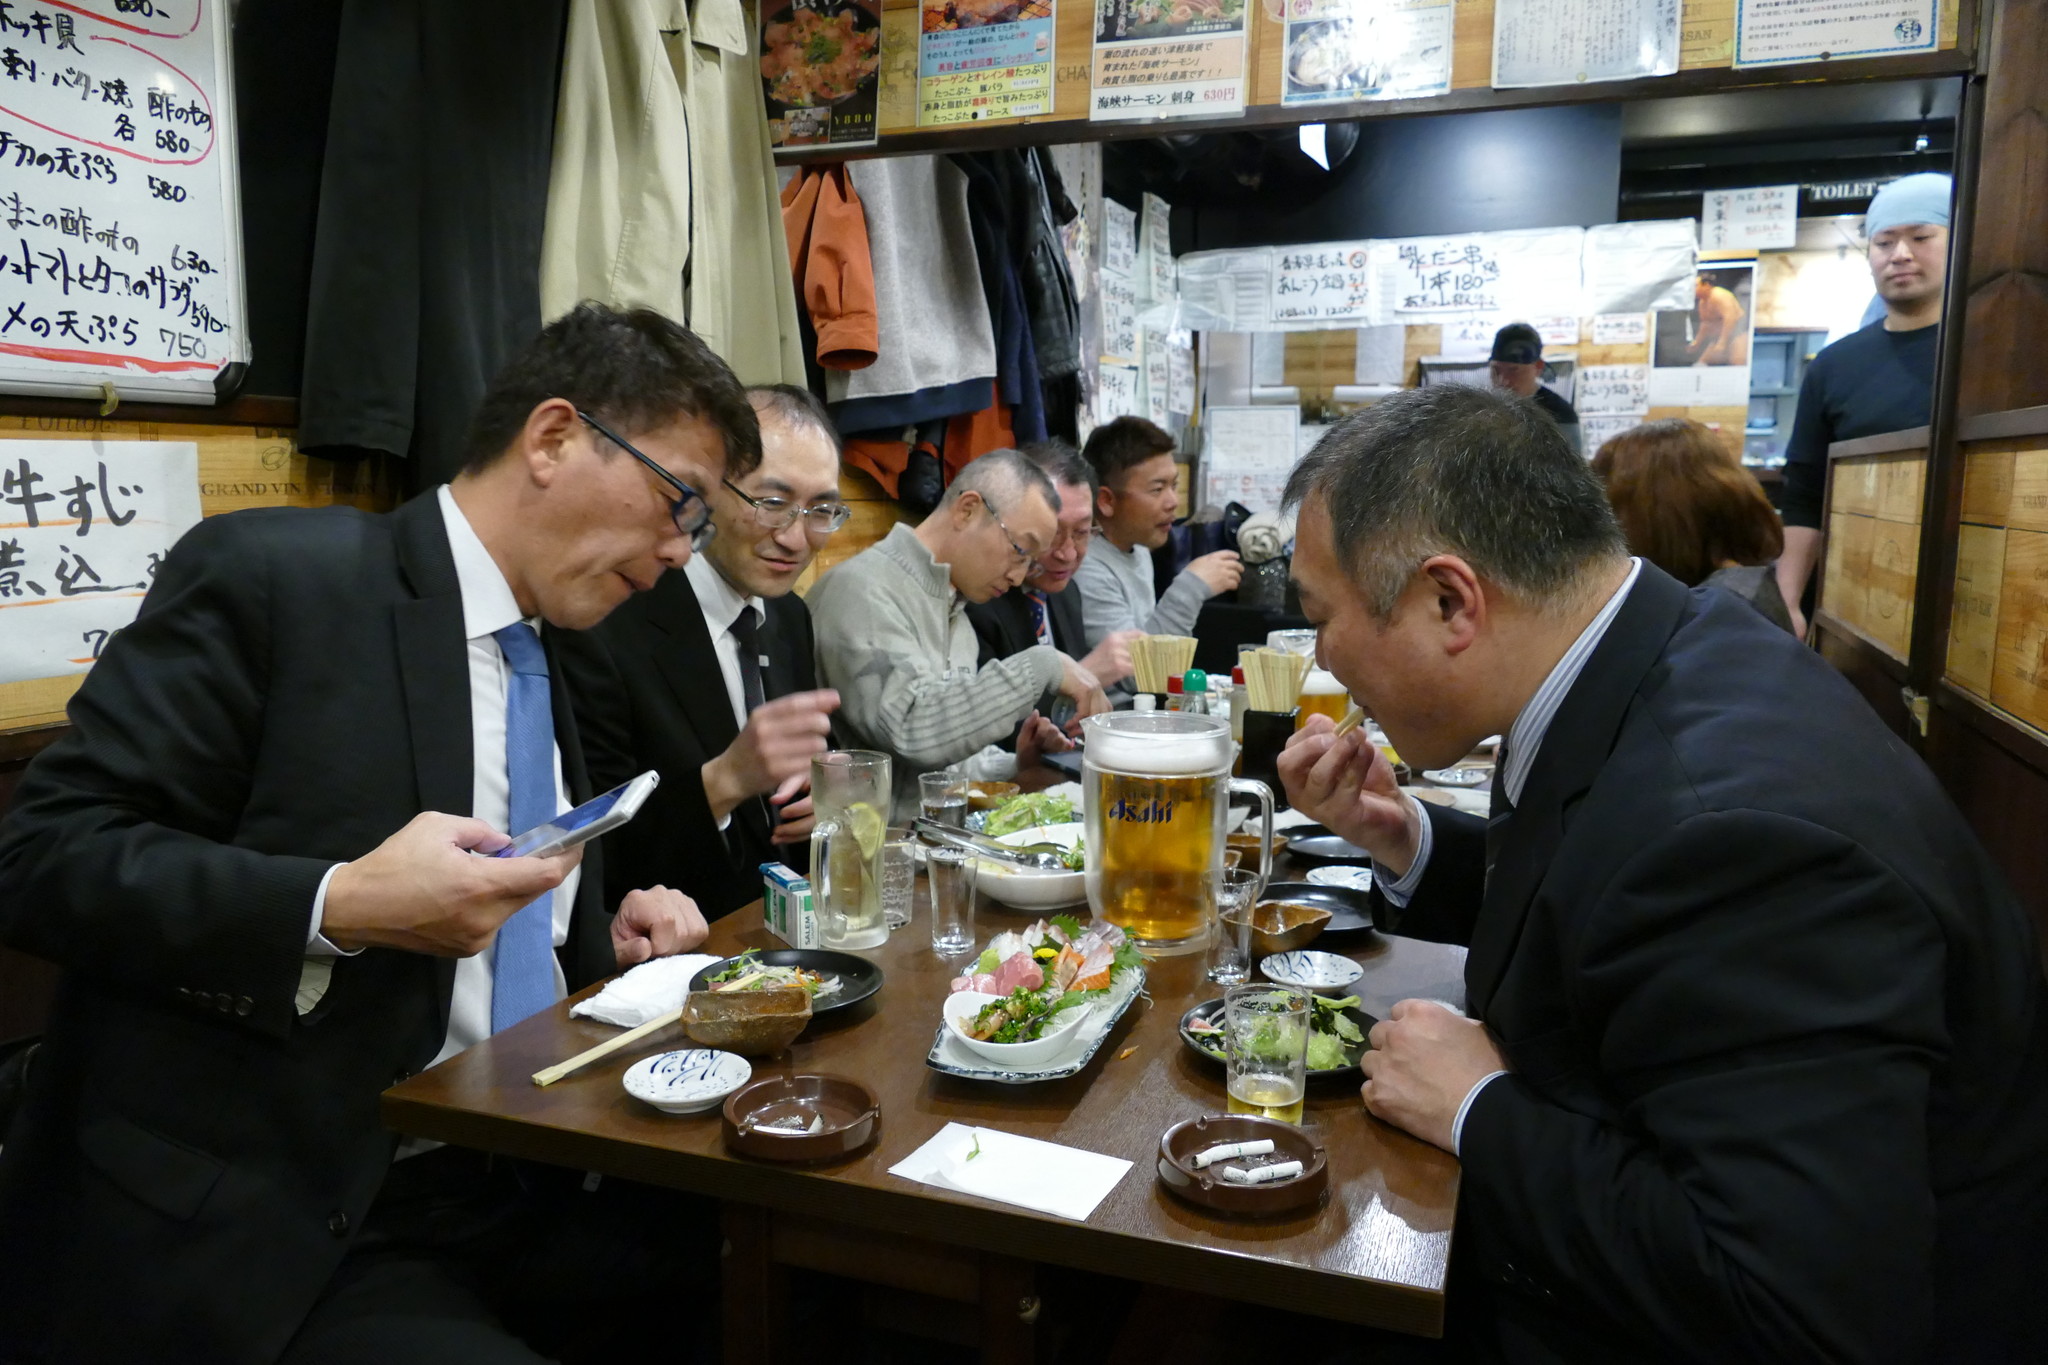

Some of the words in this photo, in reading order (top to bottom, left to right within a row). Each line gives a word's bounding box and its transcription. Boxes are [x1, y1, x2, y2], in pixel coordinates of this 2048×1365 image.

[1097, 93, 1166, 110] 海峡サーモン
[1171, 90, 1195, 104] 刺身
[1203, 87, 1236, 101] 630円
[1811, 182, 1877, 201] TOILET
[0, 191, 139, 255] まこの酢のもの
[1, 458, 144, 537] 牛すじ
[201, 483, 267, 497] GRAND
[1109, 798, 1173, 824] Asahi
